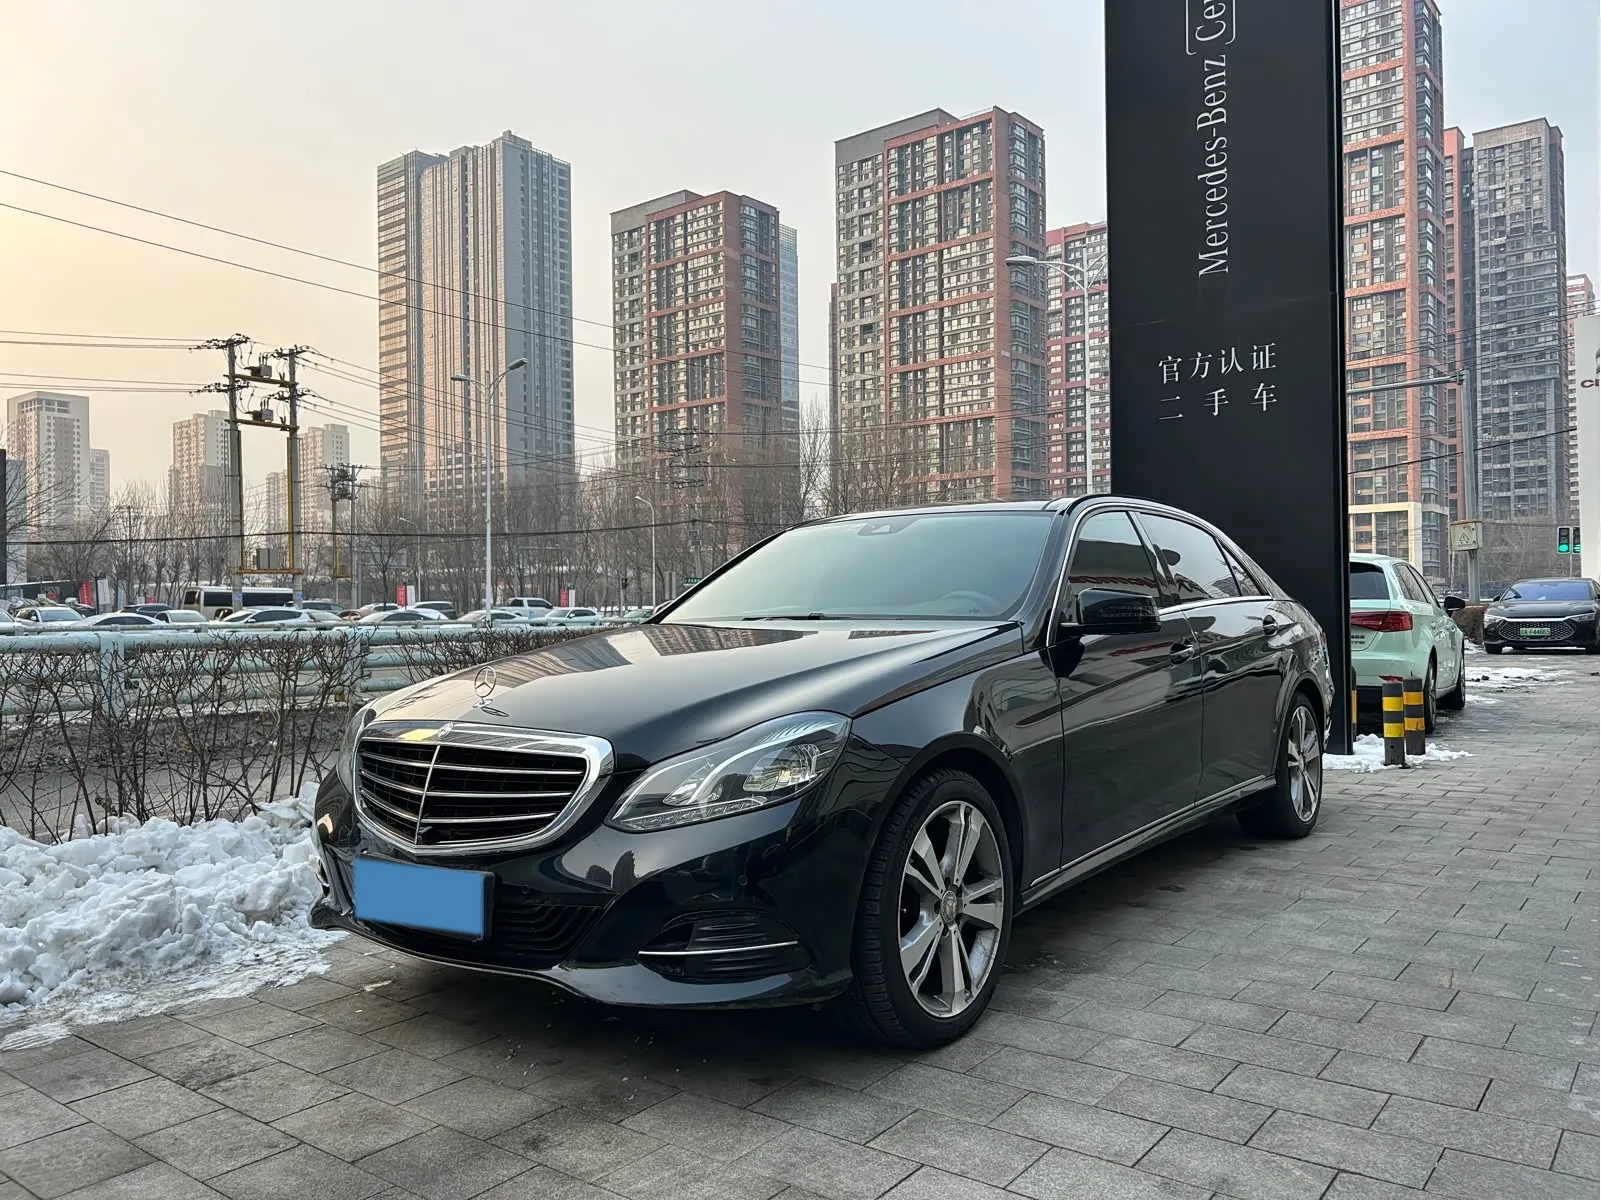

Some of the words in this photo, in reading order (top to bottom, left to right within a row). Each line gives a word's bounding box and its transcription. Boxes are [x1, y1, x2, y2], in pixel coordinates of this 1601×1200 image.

[1195, 0, 1226, 41] Ce
[1196, 54, 1229, 278] Mercedes-Benz
[1158, 342, 1277, 384] 官方认证
[1159, 382, 1278, 420] 二手车
